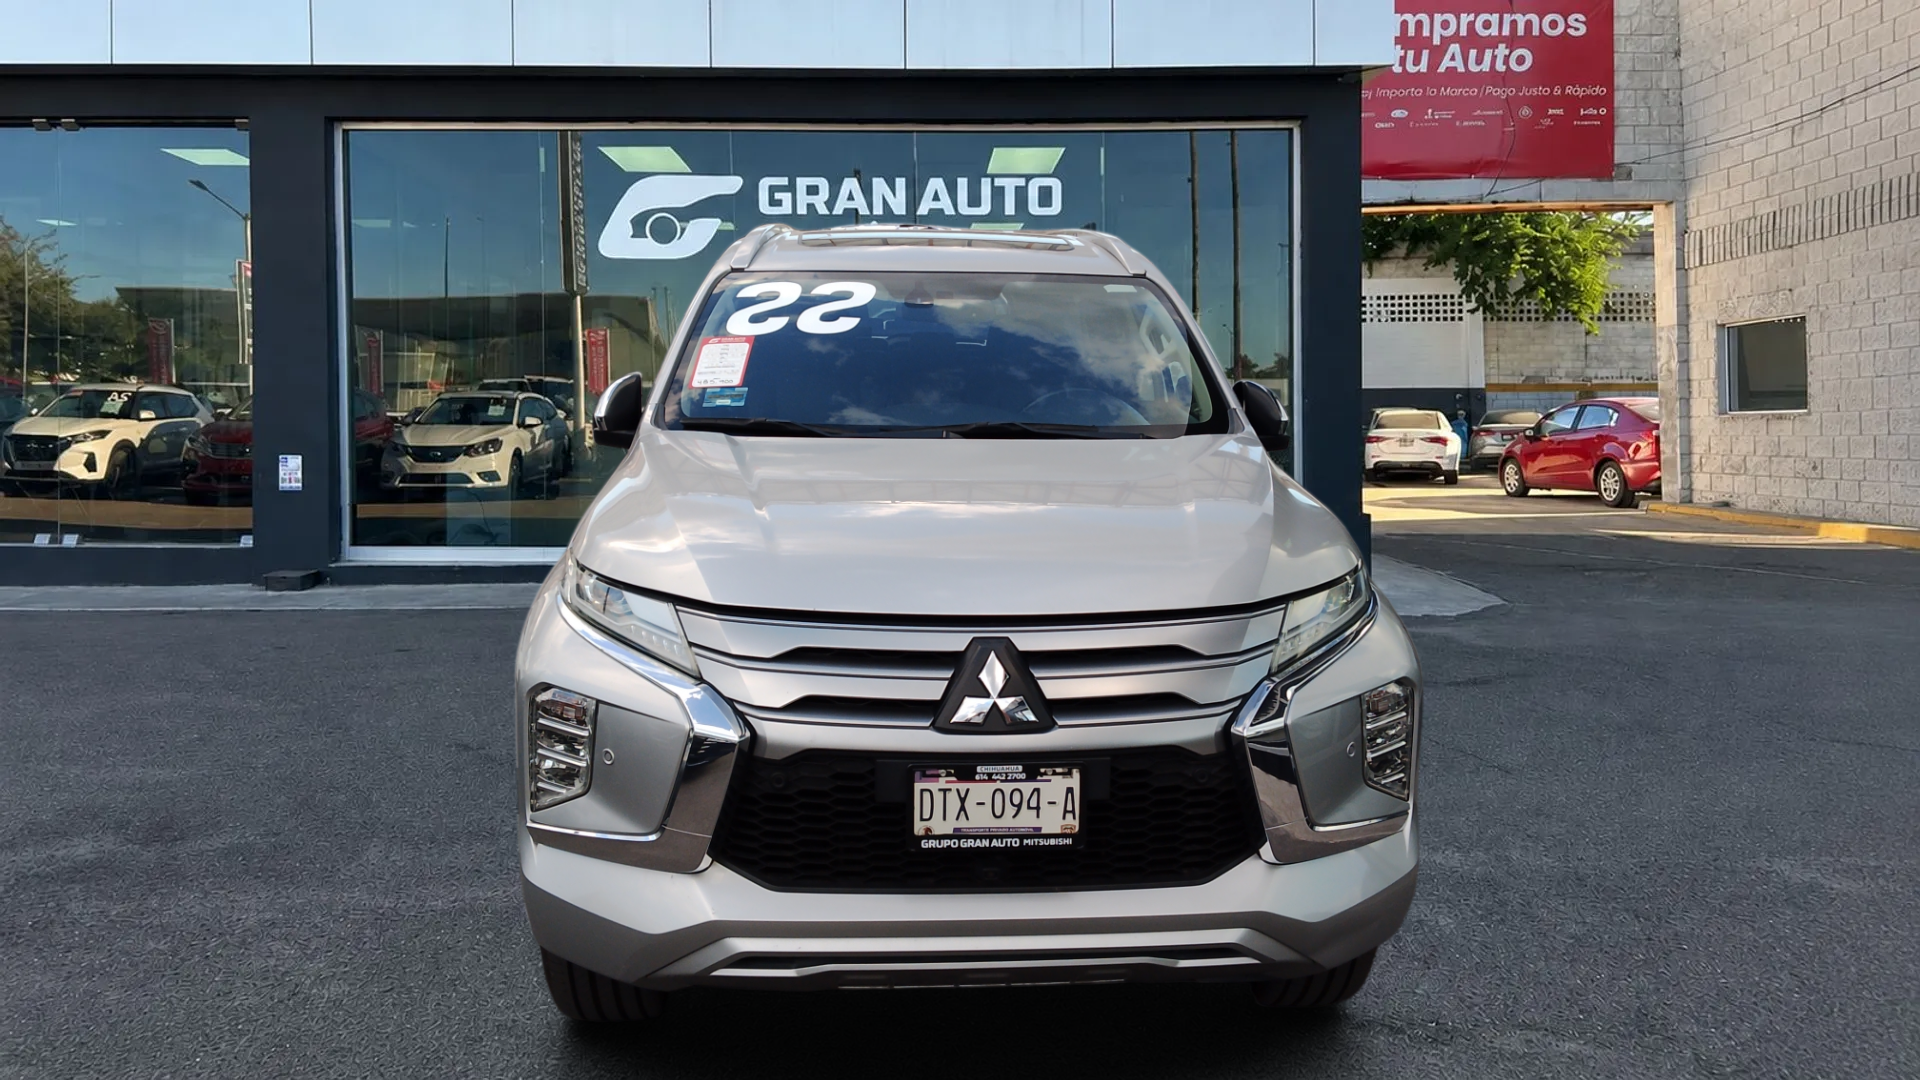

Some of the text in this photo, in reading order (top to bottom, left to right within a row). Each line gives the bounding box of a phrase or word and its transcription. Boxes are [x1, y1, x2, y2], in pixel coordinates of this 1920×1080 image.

[1393, 43, 1533, 73] tu Auto
[1376, 87, 1423, 99] Importa
[1426, 86, 1437, 96] la
[1440, 86, 1478, 97] Marca
[1518, 86, 1551, 96] Justo
[1553, 85, 1561, 96] &
[758, 177, 1063, 216] GRAN AUTO
[1007, 772, 1026, 780] 2700
[919, 786, 1077, 822] DTX-094-A
[921, 838, 1072, 848] GRUPO GRAN AUTO MITSUBISHI
